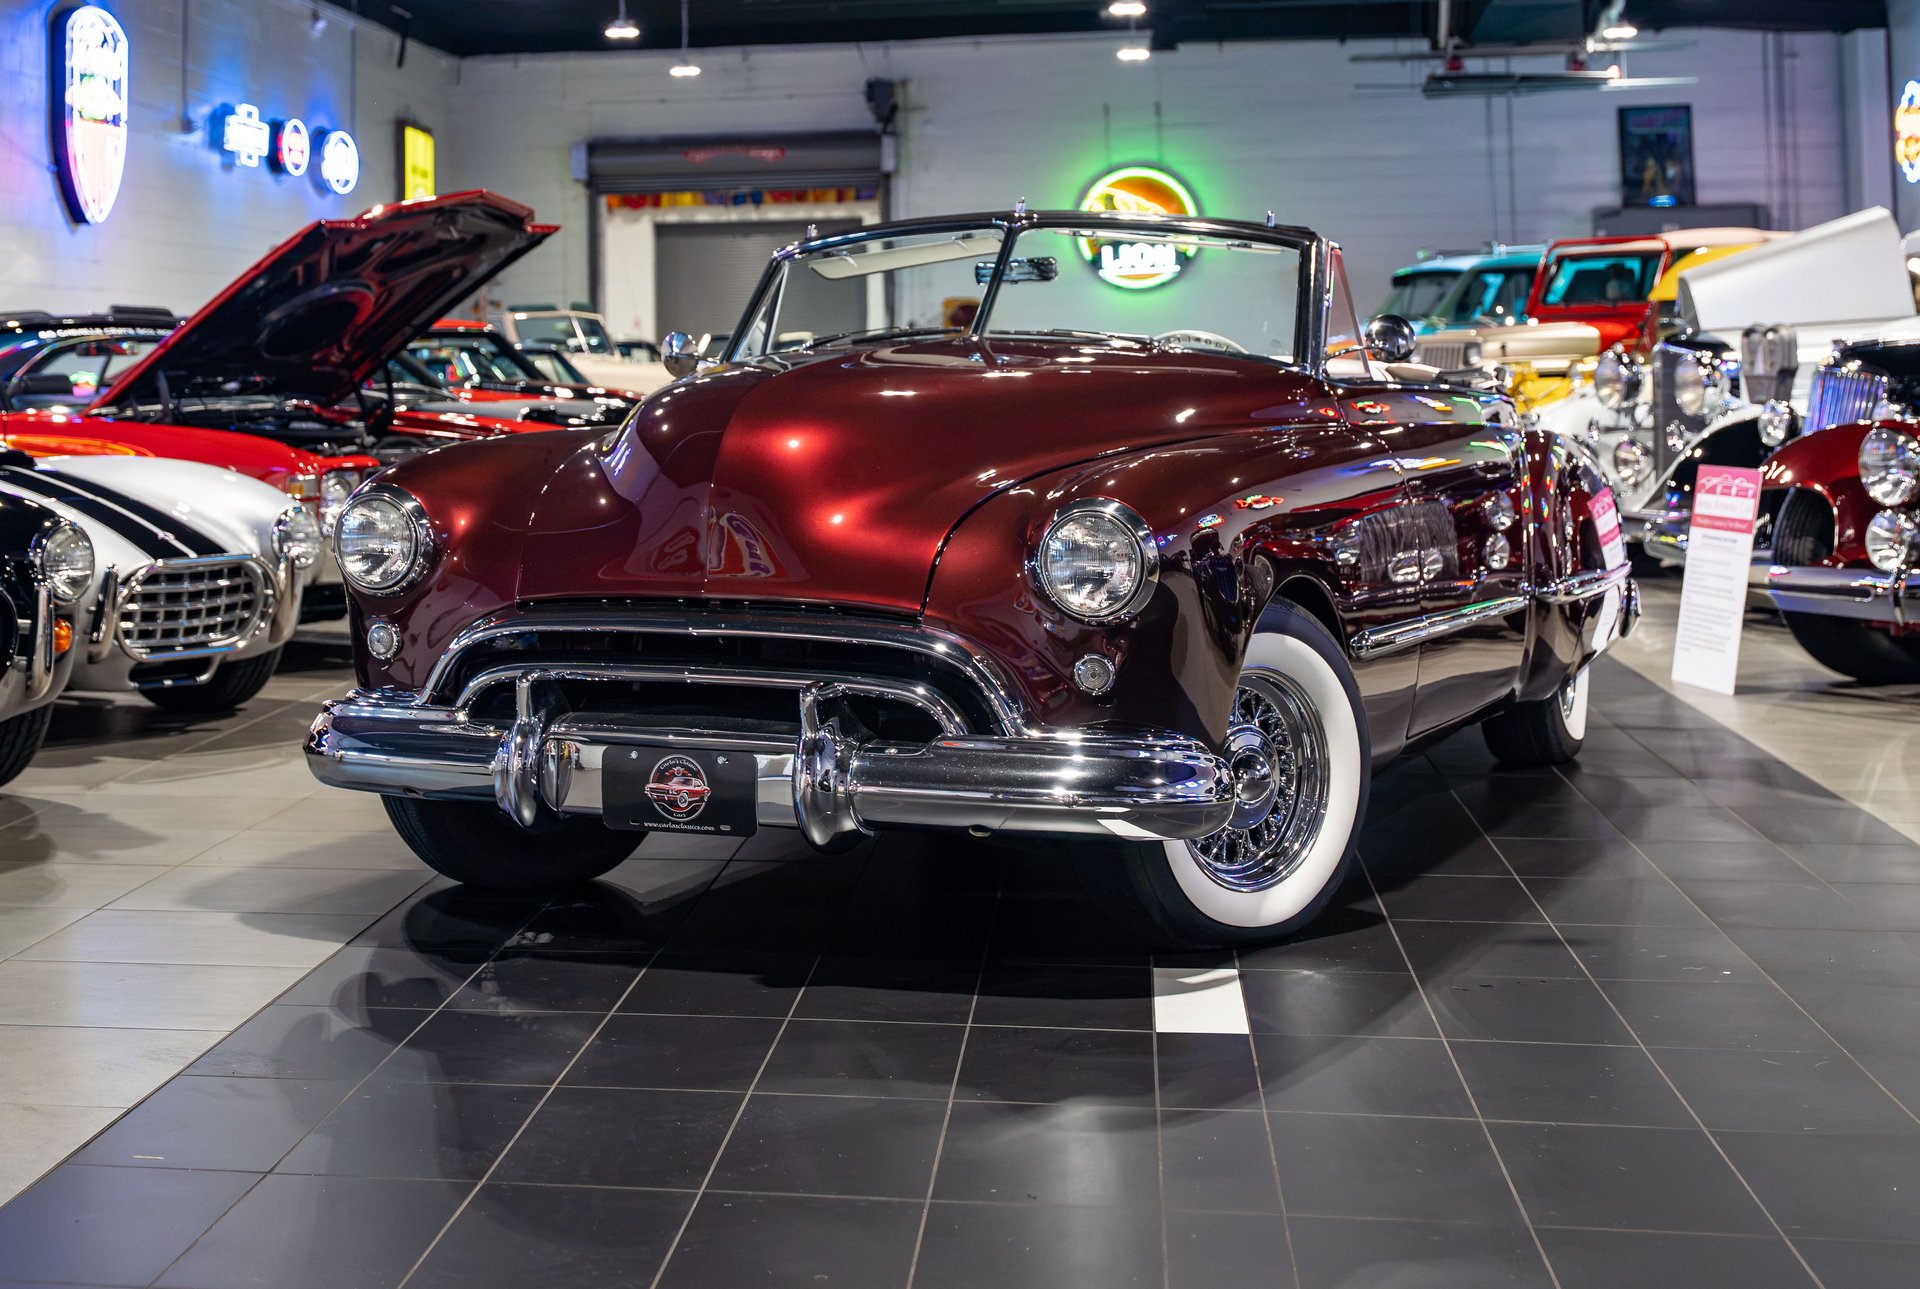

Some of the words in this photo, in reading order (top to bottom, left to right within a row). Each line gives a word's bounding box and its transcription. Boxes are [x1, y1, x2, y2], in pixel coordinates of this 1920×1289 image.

[1101, 243, 1176, 267] LION
[660, 759, 679, 770] Carla's
[644, 822, 715, 831] www.carlasclassics.com
